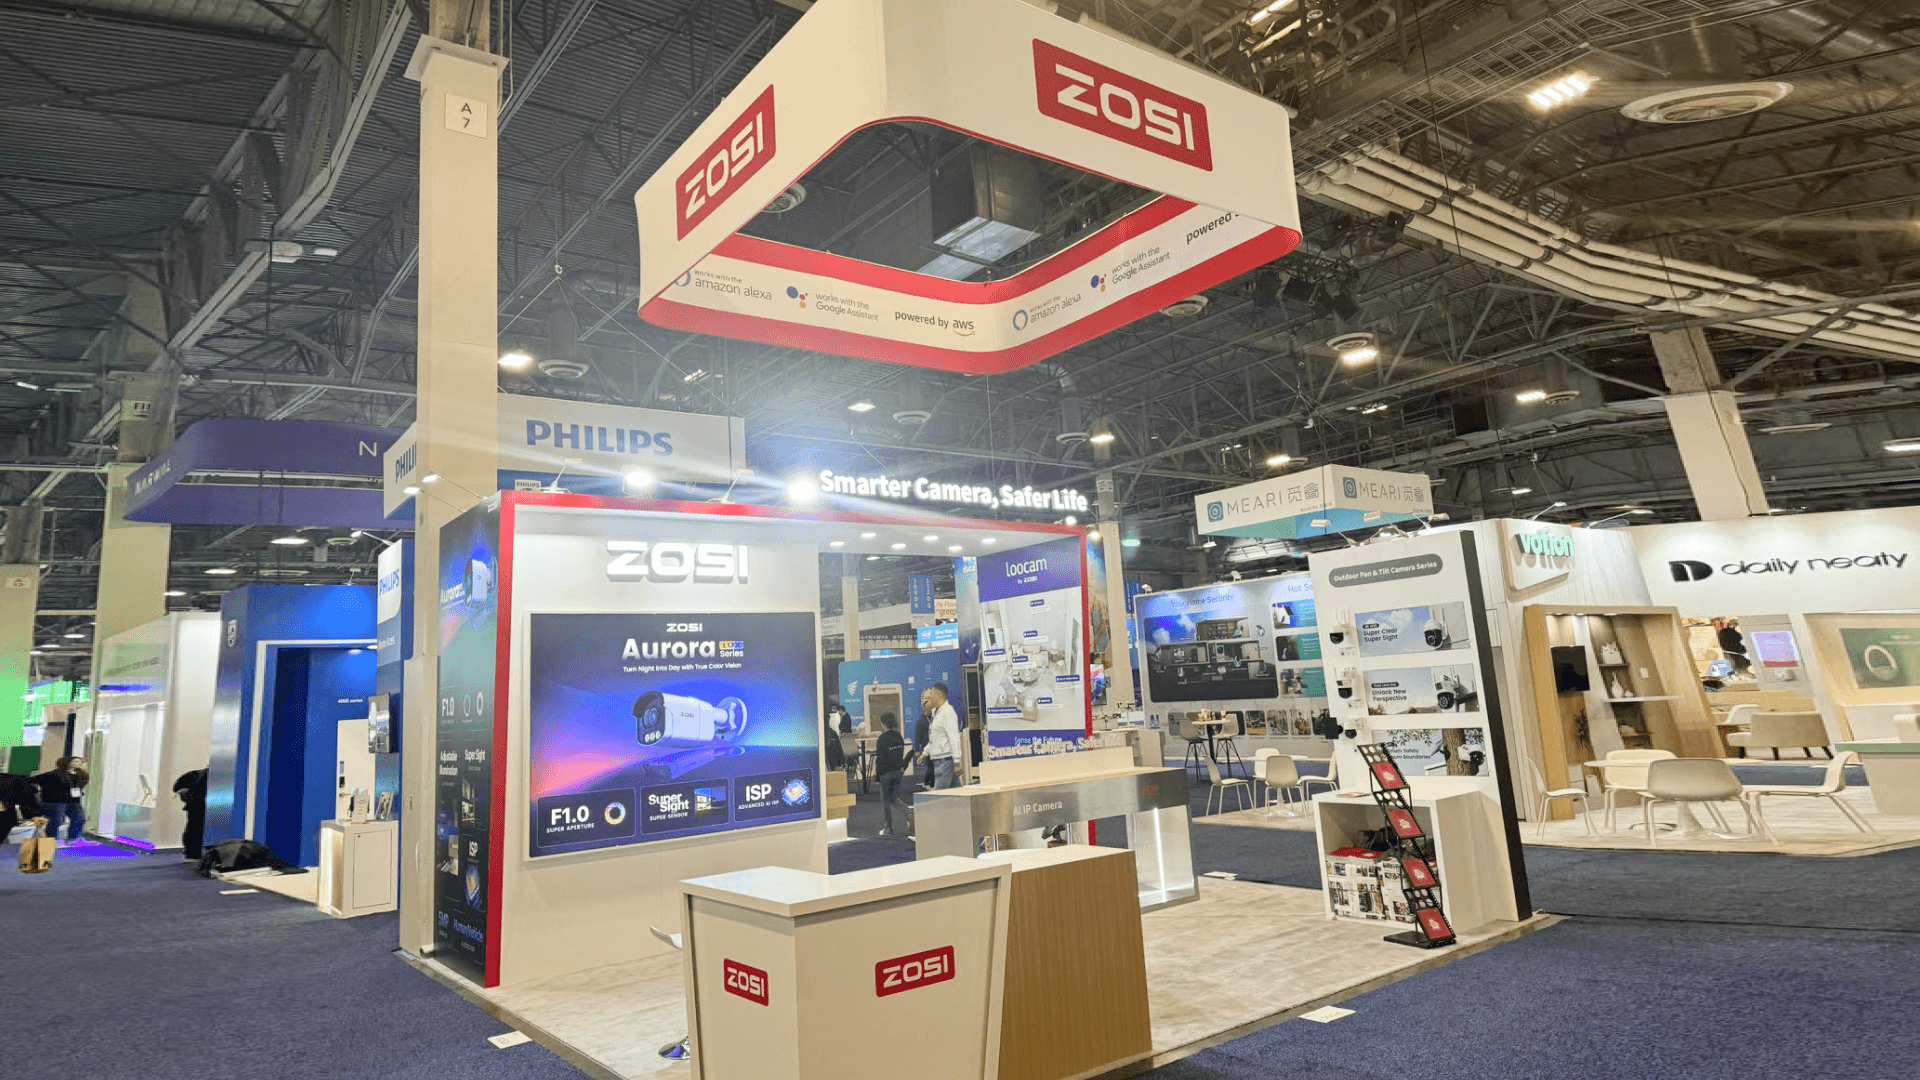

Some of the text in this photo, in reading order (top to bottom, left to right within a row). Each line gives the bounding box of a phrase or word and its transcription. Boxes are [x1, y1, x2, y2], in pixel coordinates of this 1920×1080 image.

[461, 102, 473, 115] A
[1054, 64, 1195, 151] ZOSI
[462, 117, 471, 128] 7
[685, 111, 764, 222] ZOSI
[1186, 212, 1233, 244] powered
[1112, 246, 1160, 274] works with the
[1112, 252, 1171, 285] Google Assistant
[694, 269, 742, 284] works with the
[695, 276, 772, 301] amazon alexa
[816, 292, 869, 310] works with the
[1030, 293, 1081, 324] amazon alexa
[816, 301, 879, 321] Google Assistant
[895, 310, 975, 331] powered by aws
[526, 418, 674, 458] PHILIPS
[820, 469, 1088, 511] Smarter Camera, Safer Life
[1360, 482, 1400, 500] MEARI
[1227, 490, 1282, 515] MEARI
[606, 540, 749, 582] ZOSI
[1005, 558, 1047, 577] loocam
[1721, 552, 1908, 574] daily neaty
[1334, 573, 1359, 582] Outdoor
[1360, 571, 1372, 579] Pan
[1391, 564, 1416, 574] Camera
[1416, 562, 1437, 570] Series
[1187, 597, 1205, 606] Home
[1206, 594, 1233, 604] Security
[666, 623, 703, 632] ZOSI
[1363, 629, 1380, 637] Super
[1383, 634, 1398, 642] Sight
[622, 638, 716, 660] Aurora
[719, 649, 744, 658] Series
[638, 665, 655, 673] Night
[668, 664, 680, 672] Day
[1373, 695, 1408, 703] Perspective
[648, 793, 683, 806] Super
[746, 783, 772, 802] ISP
[660, 799, 690, 813] Sight
[738, 801, 764, 809] ADVANCED
[1013, 801, 1063, 816] AI IP Camera
[551, 805, 590, 826] F1.0
[567, 823, 595, 831] APERTURE
[883, 954, 949, 988] ZOSI
[727, 967, 765, 998] ZOSI
